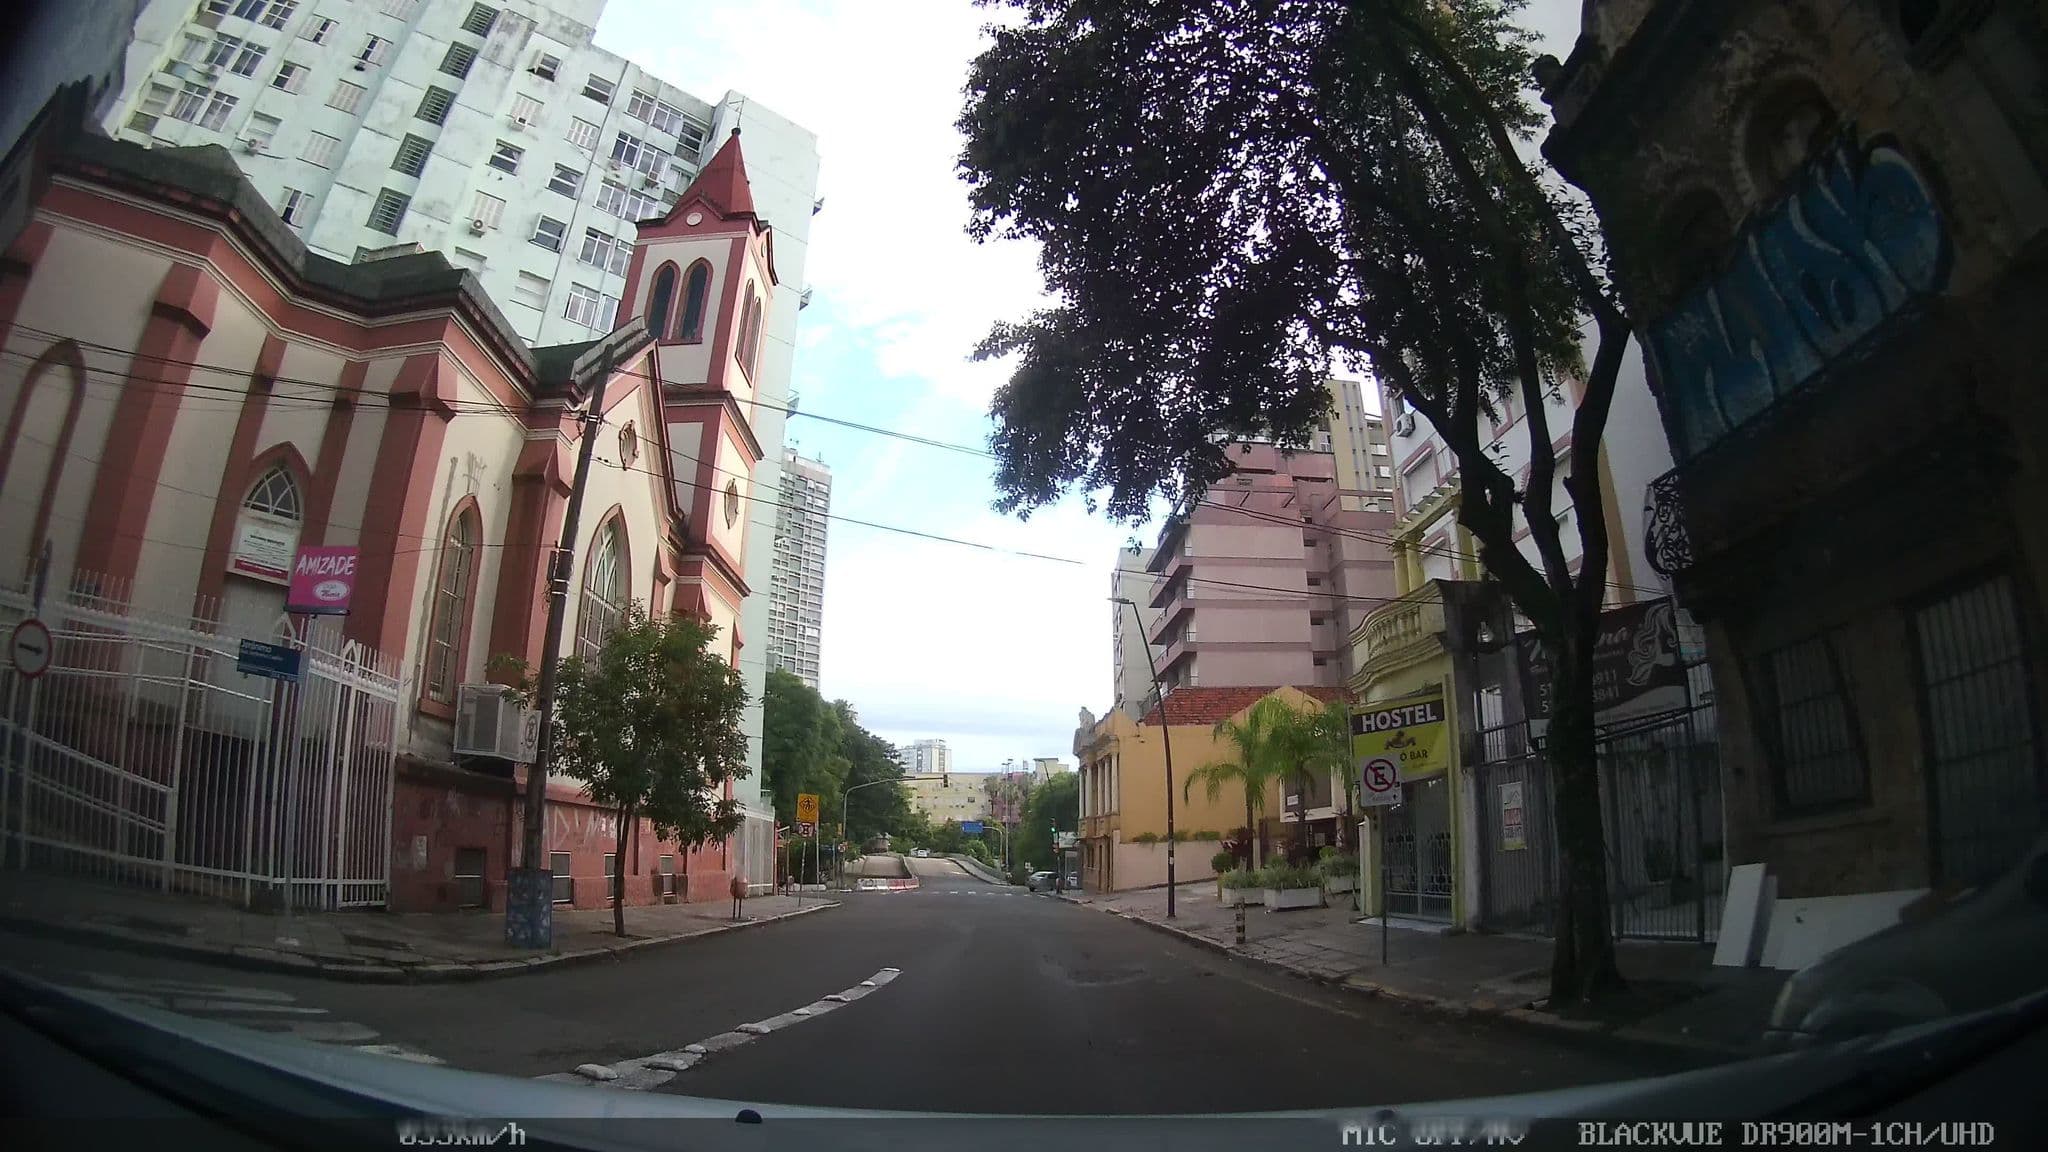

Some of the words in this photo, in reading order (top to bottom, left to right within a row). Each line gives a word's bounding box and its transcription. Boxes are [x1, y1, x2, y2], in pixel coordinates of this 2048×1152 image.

[295, 554, 356, 576] AMIZADE
[1362, 703, 1437, 732] HOSTEL
[1410, 749, 1429, 761] BAR
